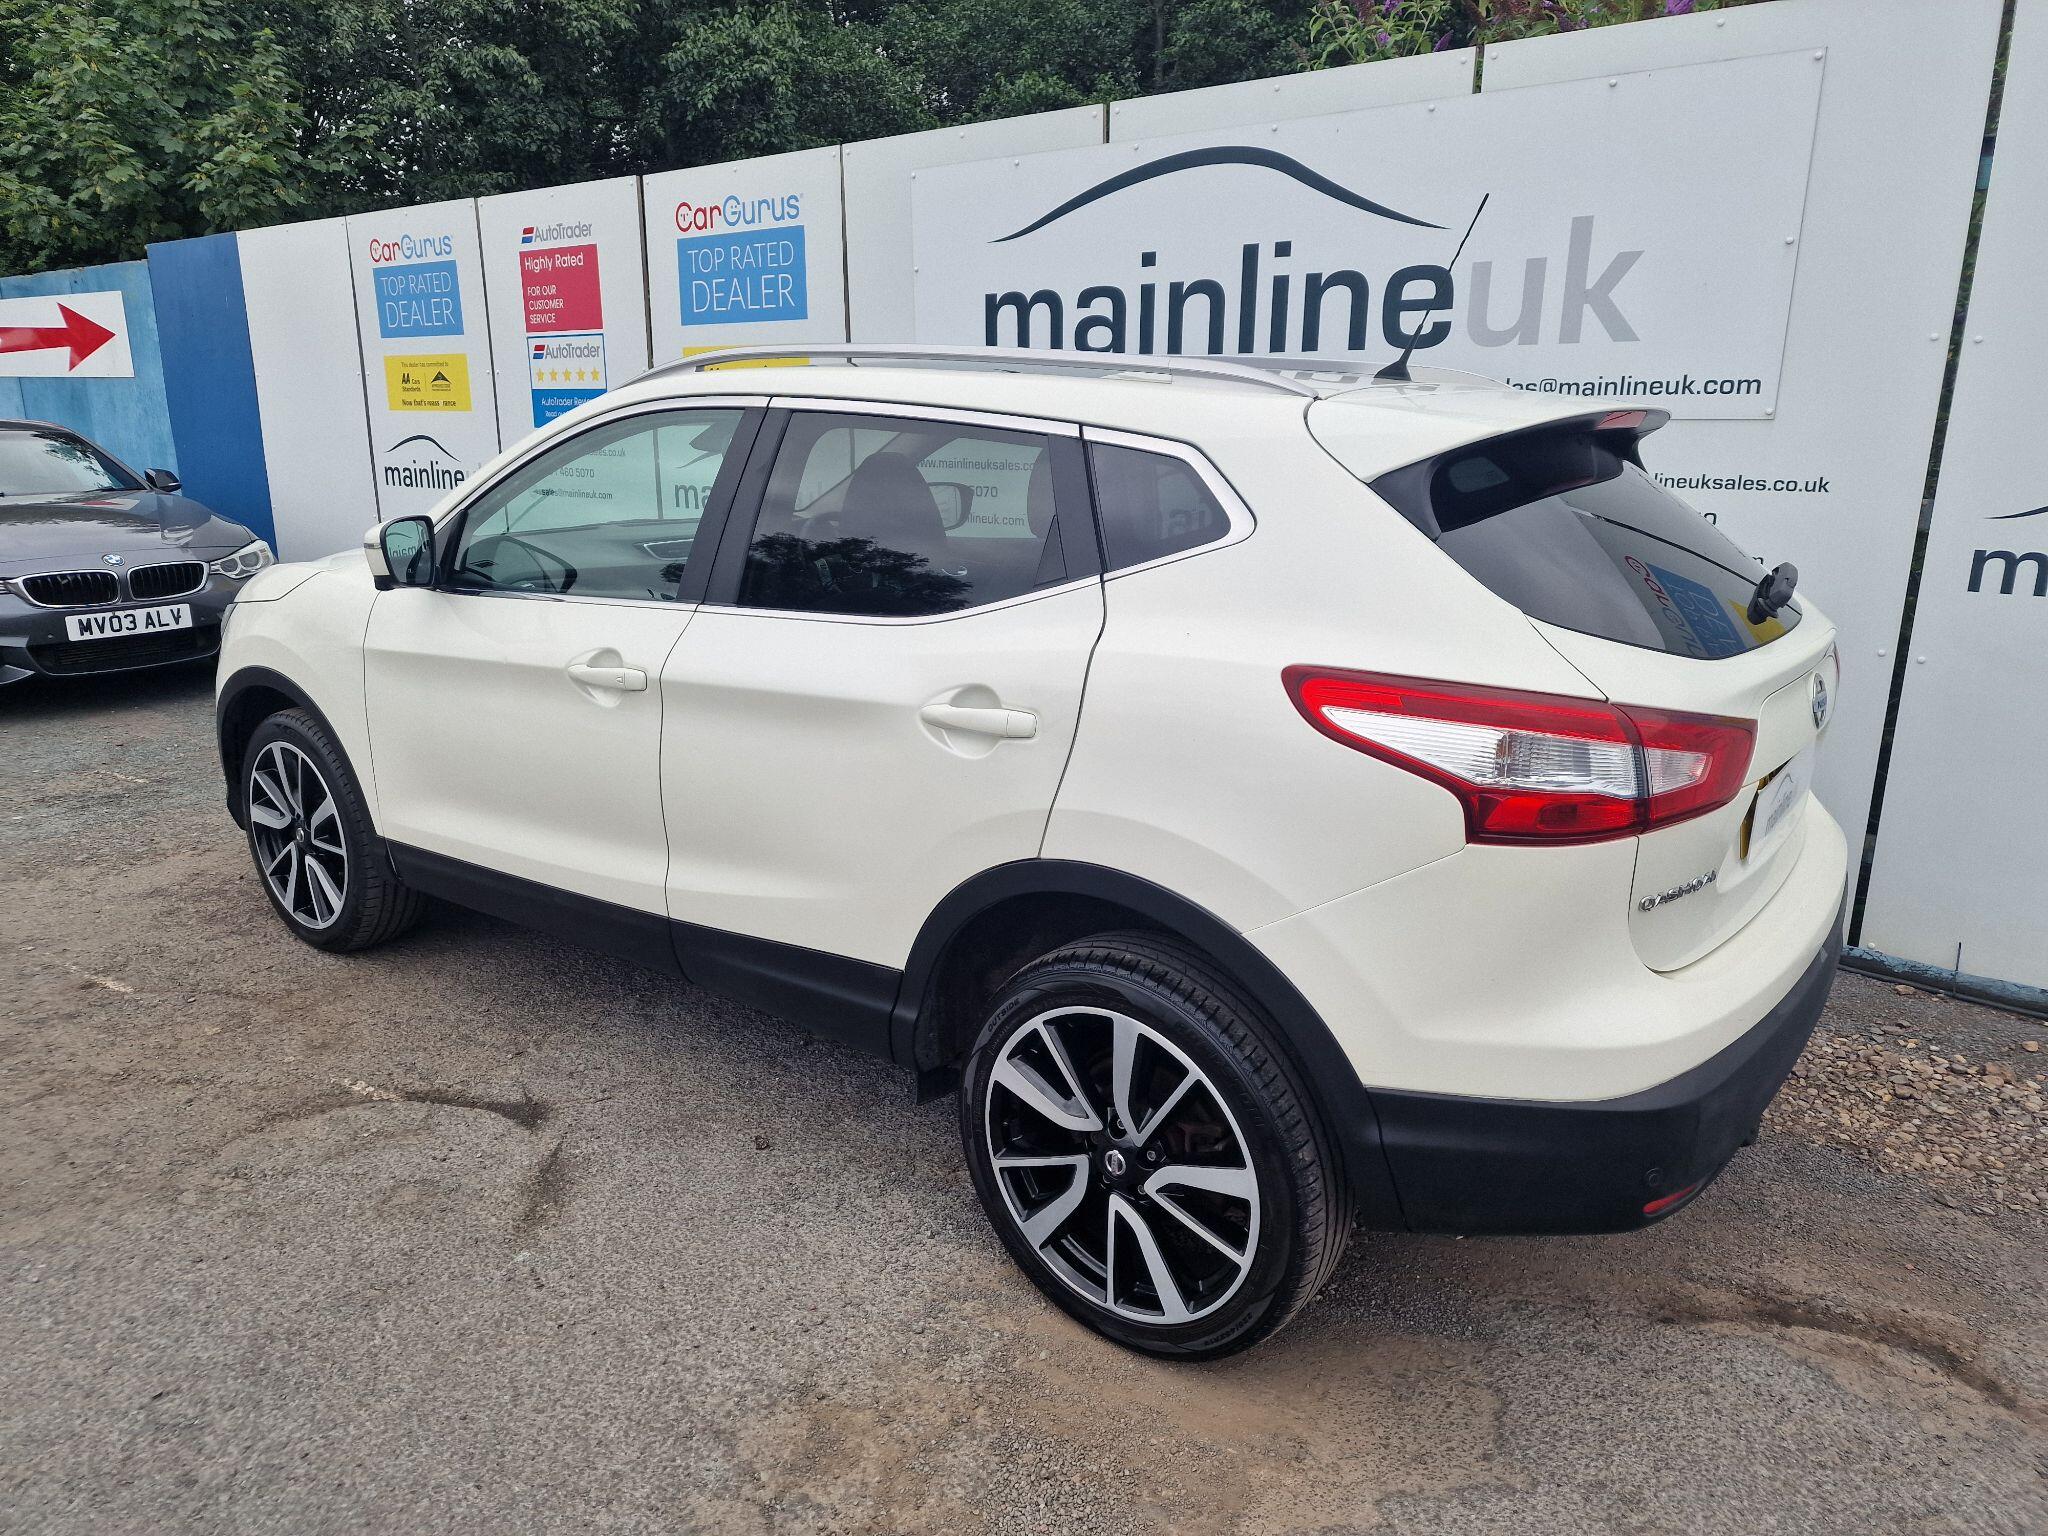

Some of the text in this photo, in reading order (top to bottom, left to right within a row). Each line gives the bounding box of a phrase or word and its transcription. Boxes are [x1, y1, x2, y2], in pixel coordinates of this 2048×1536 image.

[675, 194, 800, 233] CarGurus
[534, 221, 593, 243] AutoTrader
[369, 234, 453, 263] CarGurus
[688, 240, 794, 274] TOP RATED
[525, 252, 584, 273] Highly Rated
[380, 271, 452, 296] TOP RATED
[527, 285, 557, 297] FOR OUR
[692, 273, 796, 313] DEALER
[385, 297, 456, 328] DEALER
[528, 298, 564, 311] CUSTOMER
[530, 313, 556, 324] SERVICE
[545, 342, 600, 360] AutoTrader
[401, 372, 411, 385] AA
[402, 399, 413, 407] Now
[541, 396, 573, 406] AutoTrader
[384, 459, 480, 490] mainline
[576, 467, 595, 478] 5070
[77, 607, 182, 637] MV03 ALV
[987, 997, 1021, 1033] OUTSIDE
